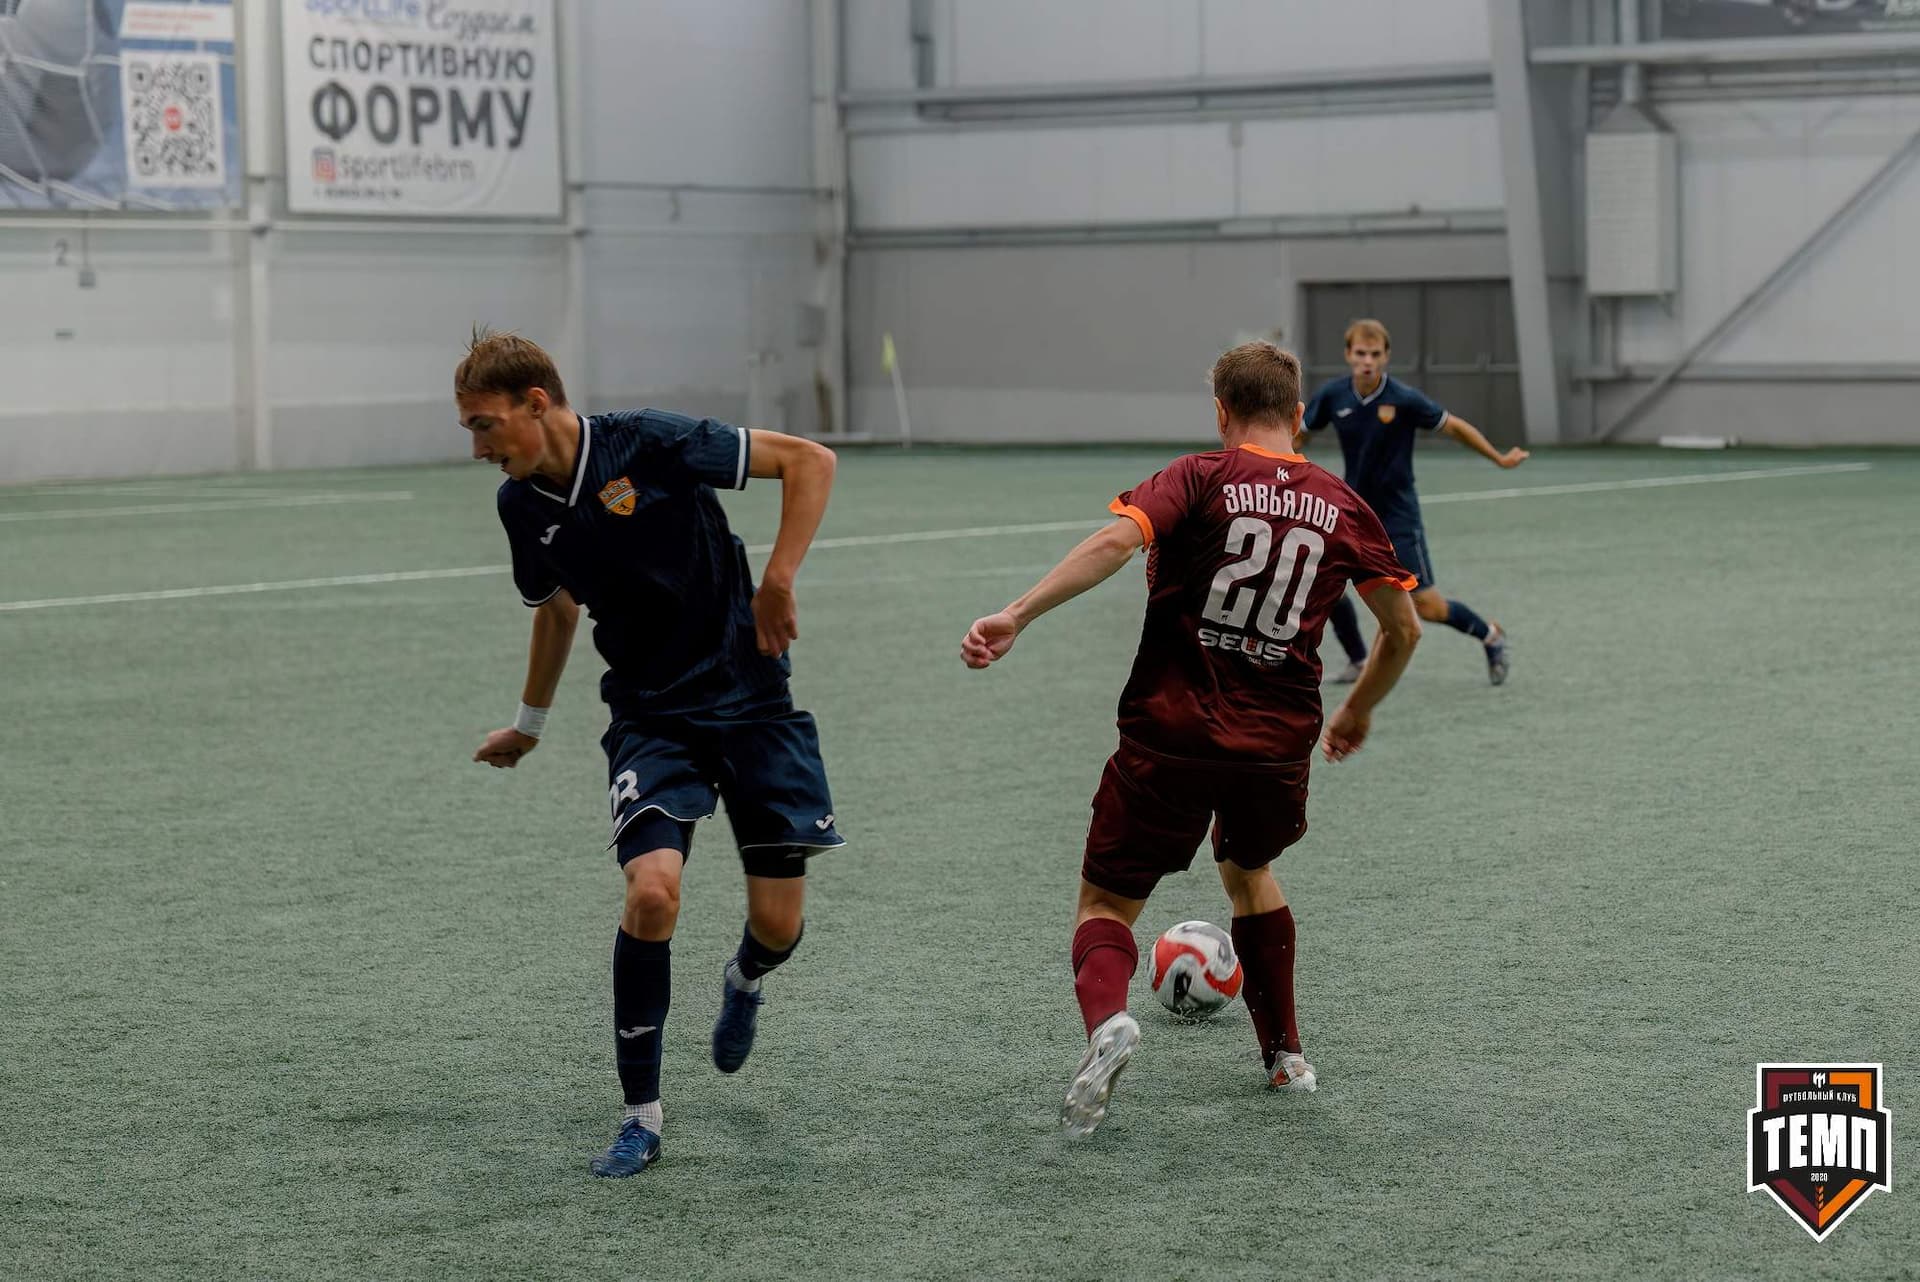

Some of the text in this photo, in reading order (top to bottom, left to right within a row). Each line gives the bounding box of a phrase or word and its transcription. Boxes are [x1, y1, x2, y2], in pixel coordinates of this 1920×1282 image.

[308, 34, 535, 81] СПОРТИВНУЮ
[312, 82, 532, 149] ФОРМУ
[1222, 483, 1340, 534] ЗАВЬЯЛОВ
[1201, 516, 1325, 641] 20
[1198, 627, 1288, 661] SEUS
